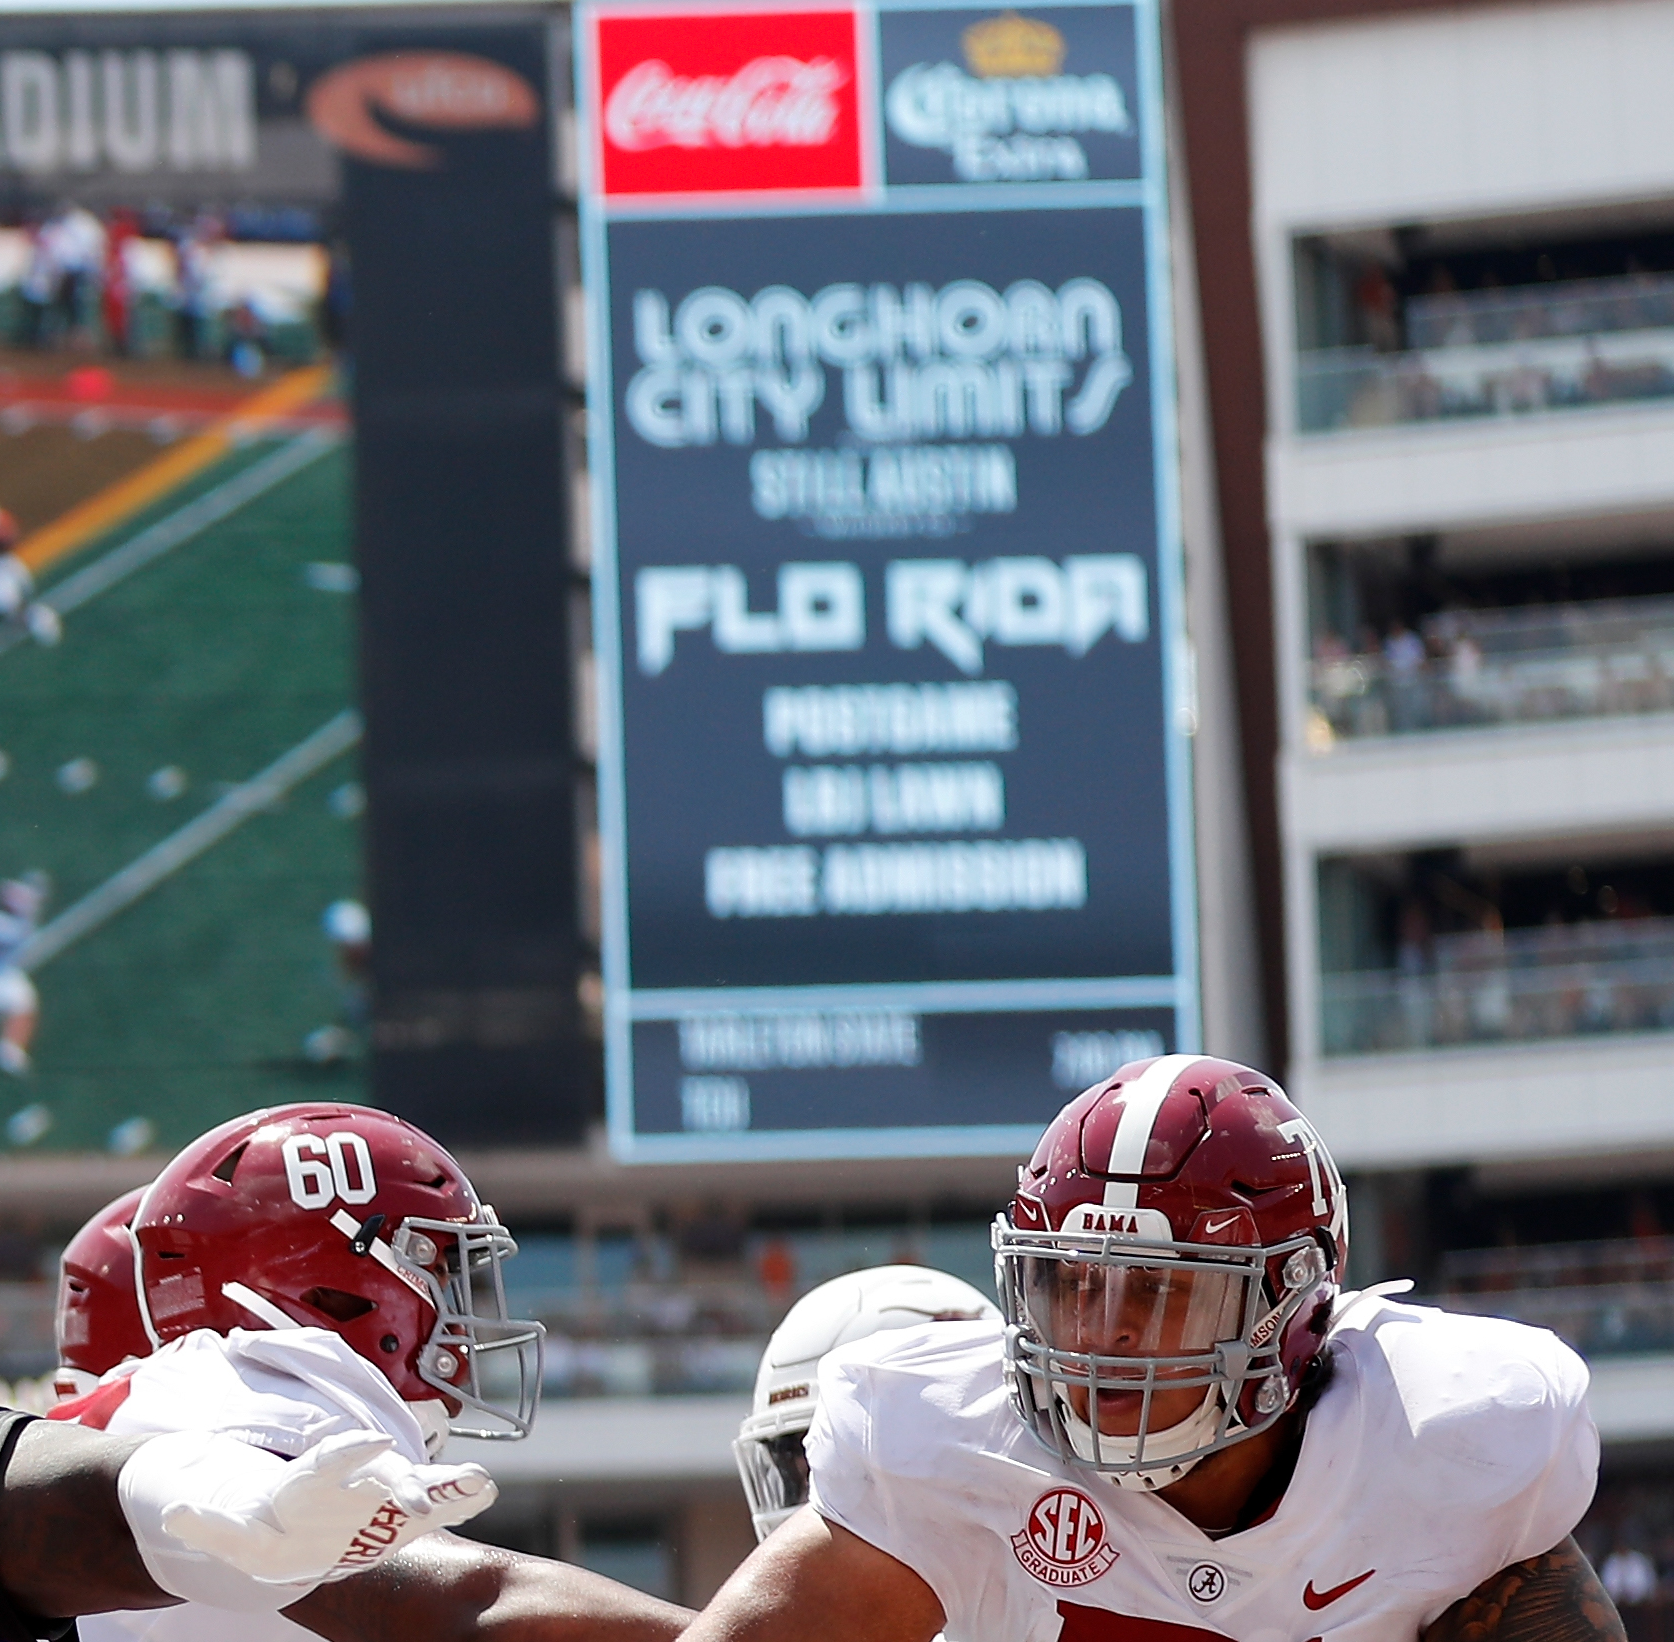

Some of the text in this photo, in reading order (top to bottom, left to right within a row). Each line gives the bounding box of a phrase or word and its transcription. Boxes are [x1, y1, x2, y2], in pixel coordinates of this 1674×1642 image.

[633, 276, 1123, 366] LONGHORN
[626, 352, 1133, 447] CITY LIMITS
[635, 553, 1149, 677] FLO RIDA
[281, 1131, 378, 1211] 60
[1082, 1212, 1139, 1233] BAMA
[1020, 1548, 1102, 1585] GRADUATE
[1033, 1492, 1100, 1562] SEC
